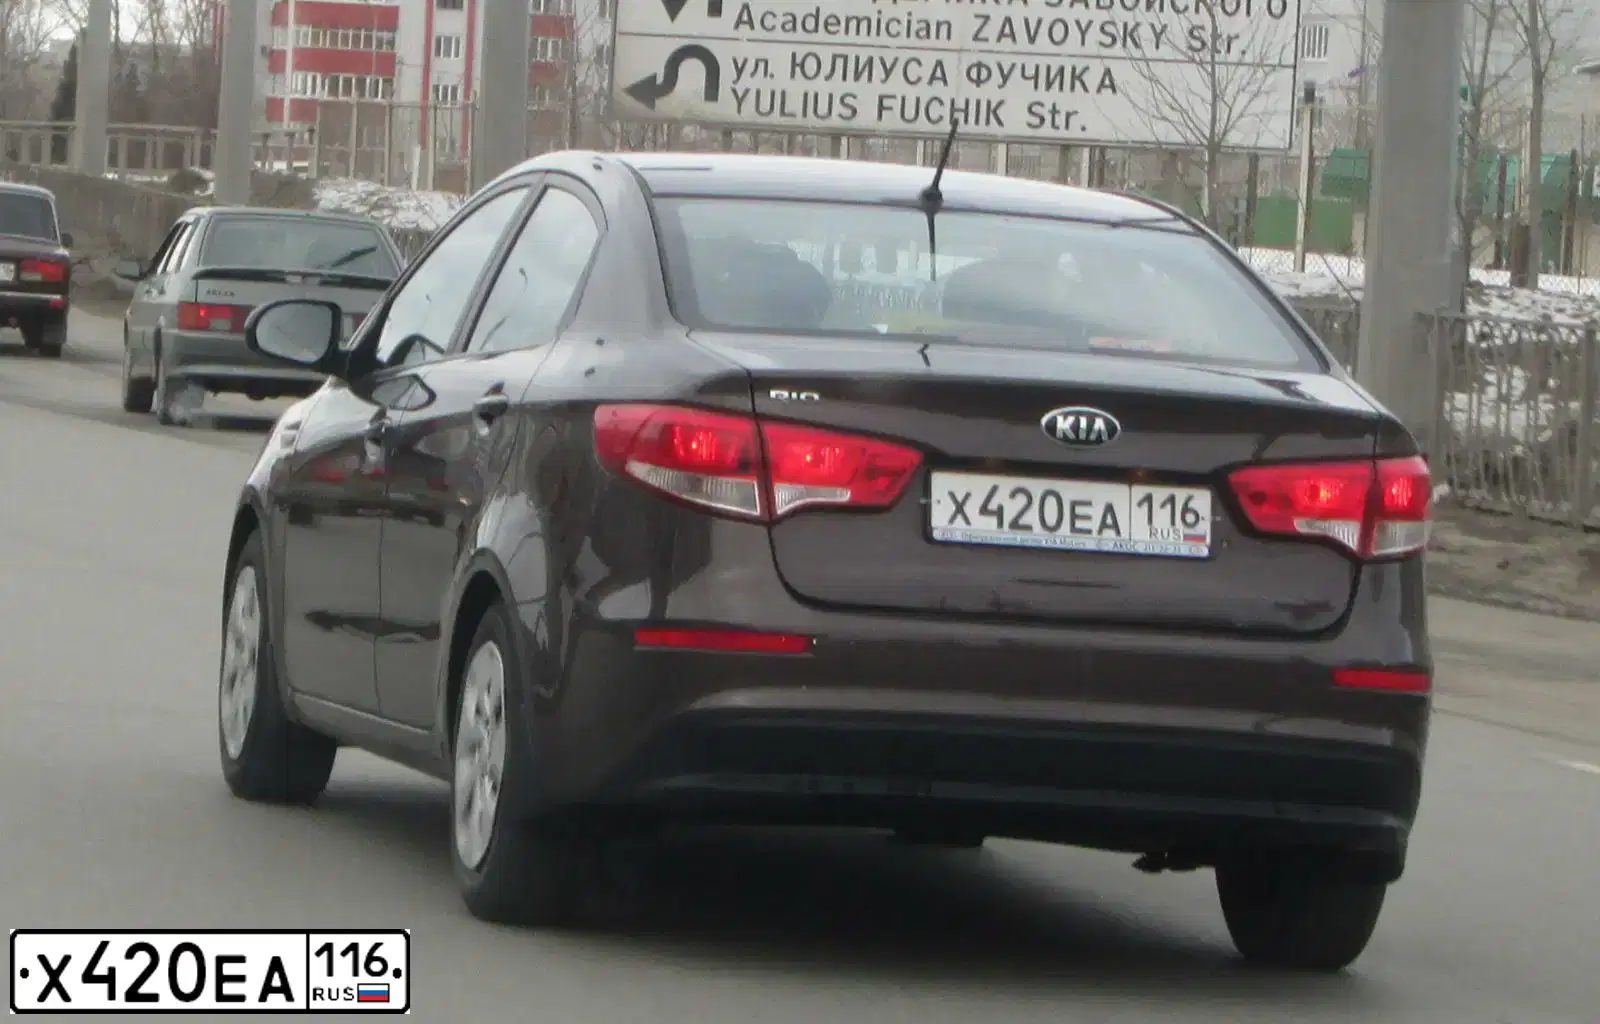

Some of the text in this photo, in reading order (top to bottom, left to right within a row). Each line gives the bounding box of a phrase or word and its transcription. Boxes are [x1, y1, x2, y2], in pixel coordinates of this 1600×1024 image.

[733, 2, 952, 41] Academician
[972, 13, 1168, 50] ZAVOYSKY
[732, 51, 1118, 95] ул. ЮЛИУСА ФУЧИКА
[730, 86, 1087, 132] YULIUS FUCHIK Str.
[1056, 415, 1108, 440] KIA
[947, 484, 1122, 537] Х420ЕА
[1136, 492, 1201, 529] 116
[1149, 527, 1181, 541] RUS
